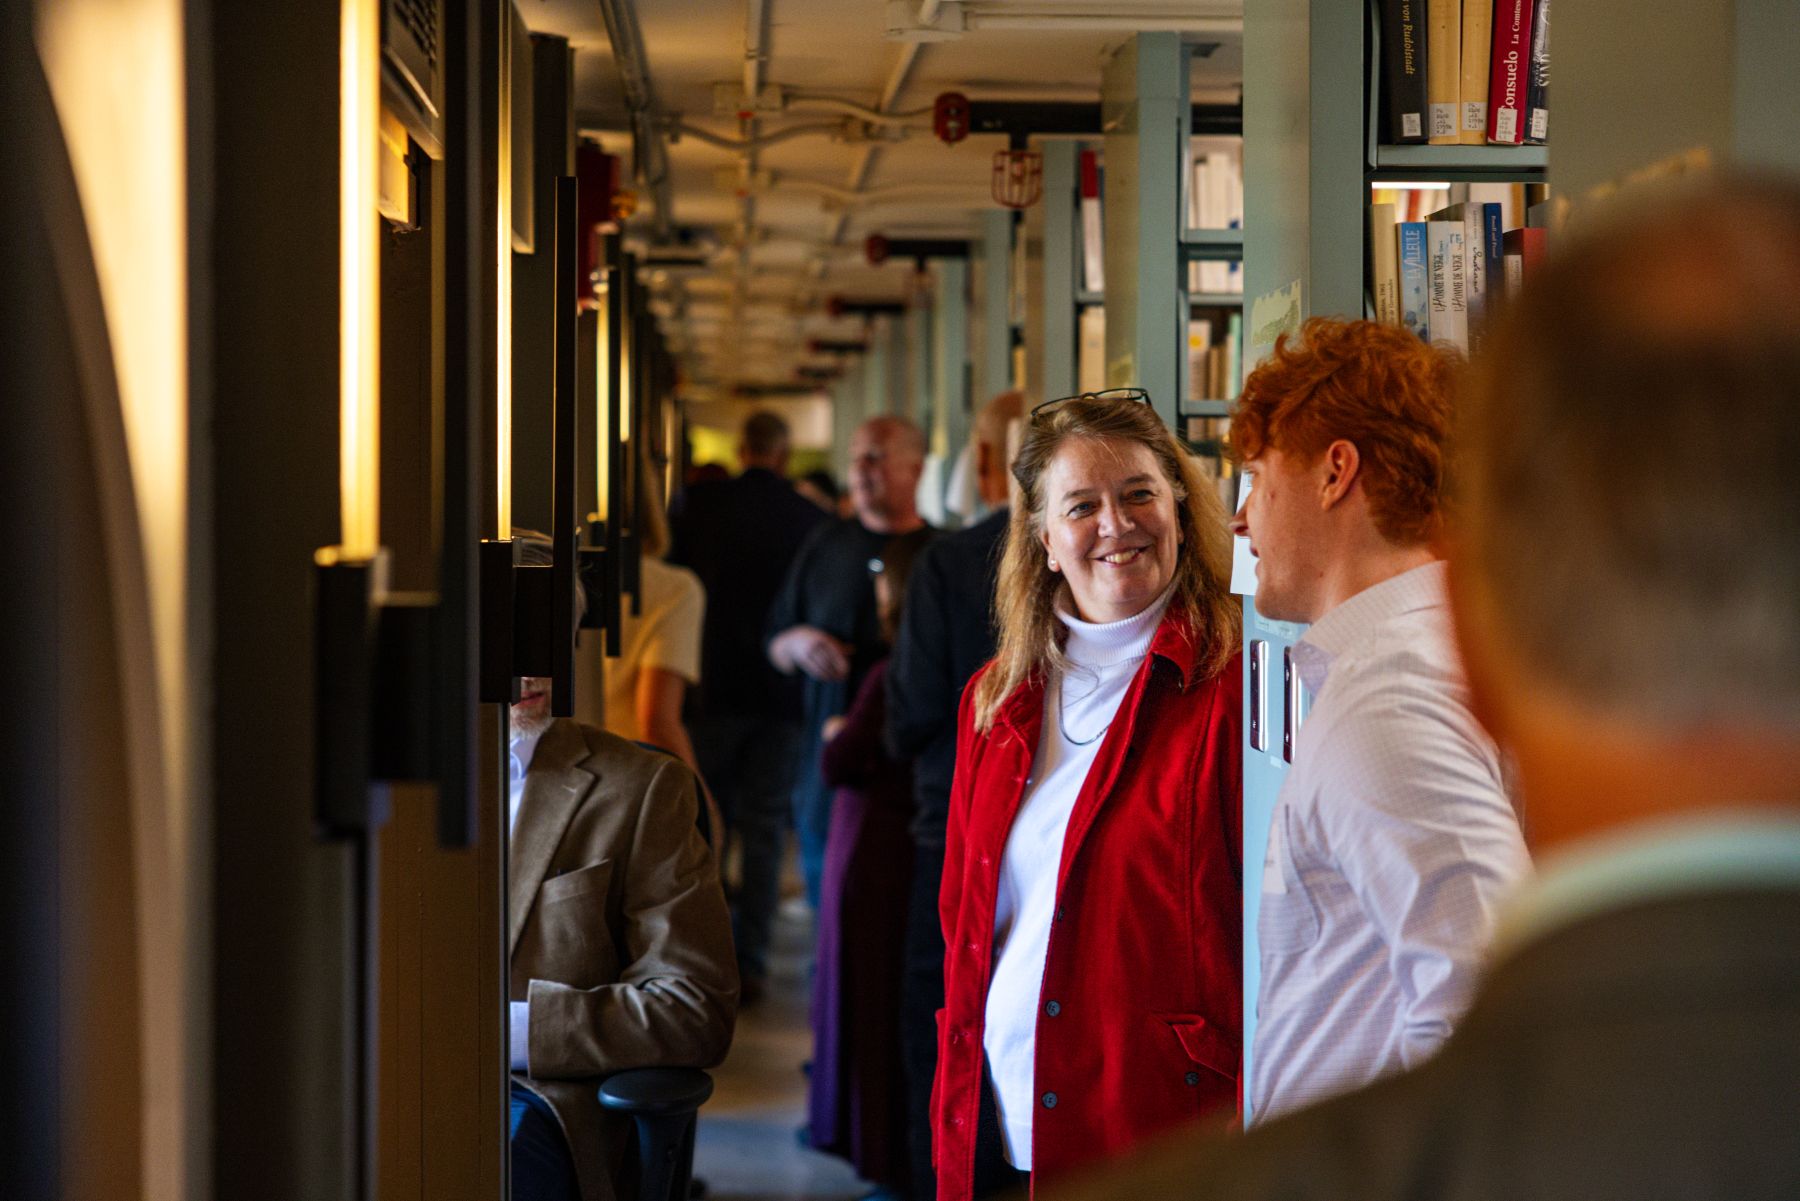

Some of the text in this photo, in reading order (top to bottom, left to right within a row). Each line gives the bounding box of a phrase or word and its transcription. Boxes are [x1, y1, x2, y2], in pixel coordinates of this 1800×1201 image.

[1402, 4, 1410, 22] von
[1403, 25, 1416, 74] Rudolstadt
[1511, 34, 1519, 44] La
[1433, 272, 1444, 280] DE
[1453, 272, 1463, 280] DE
[1472, 247, 1483, 293] Indiana
[1432, 281, 1447, 312] L'HOMME
[1452, 281, 1465, 312] L'HOMME
